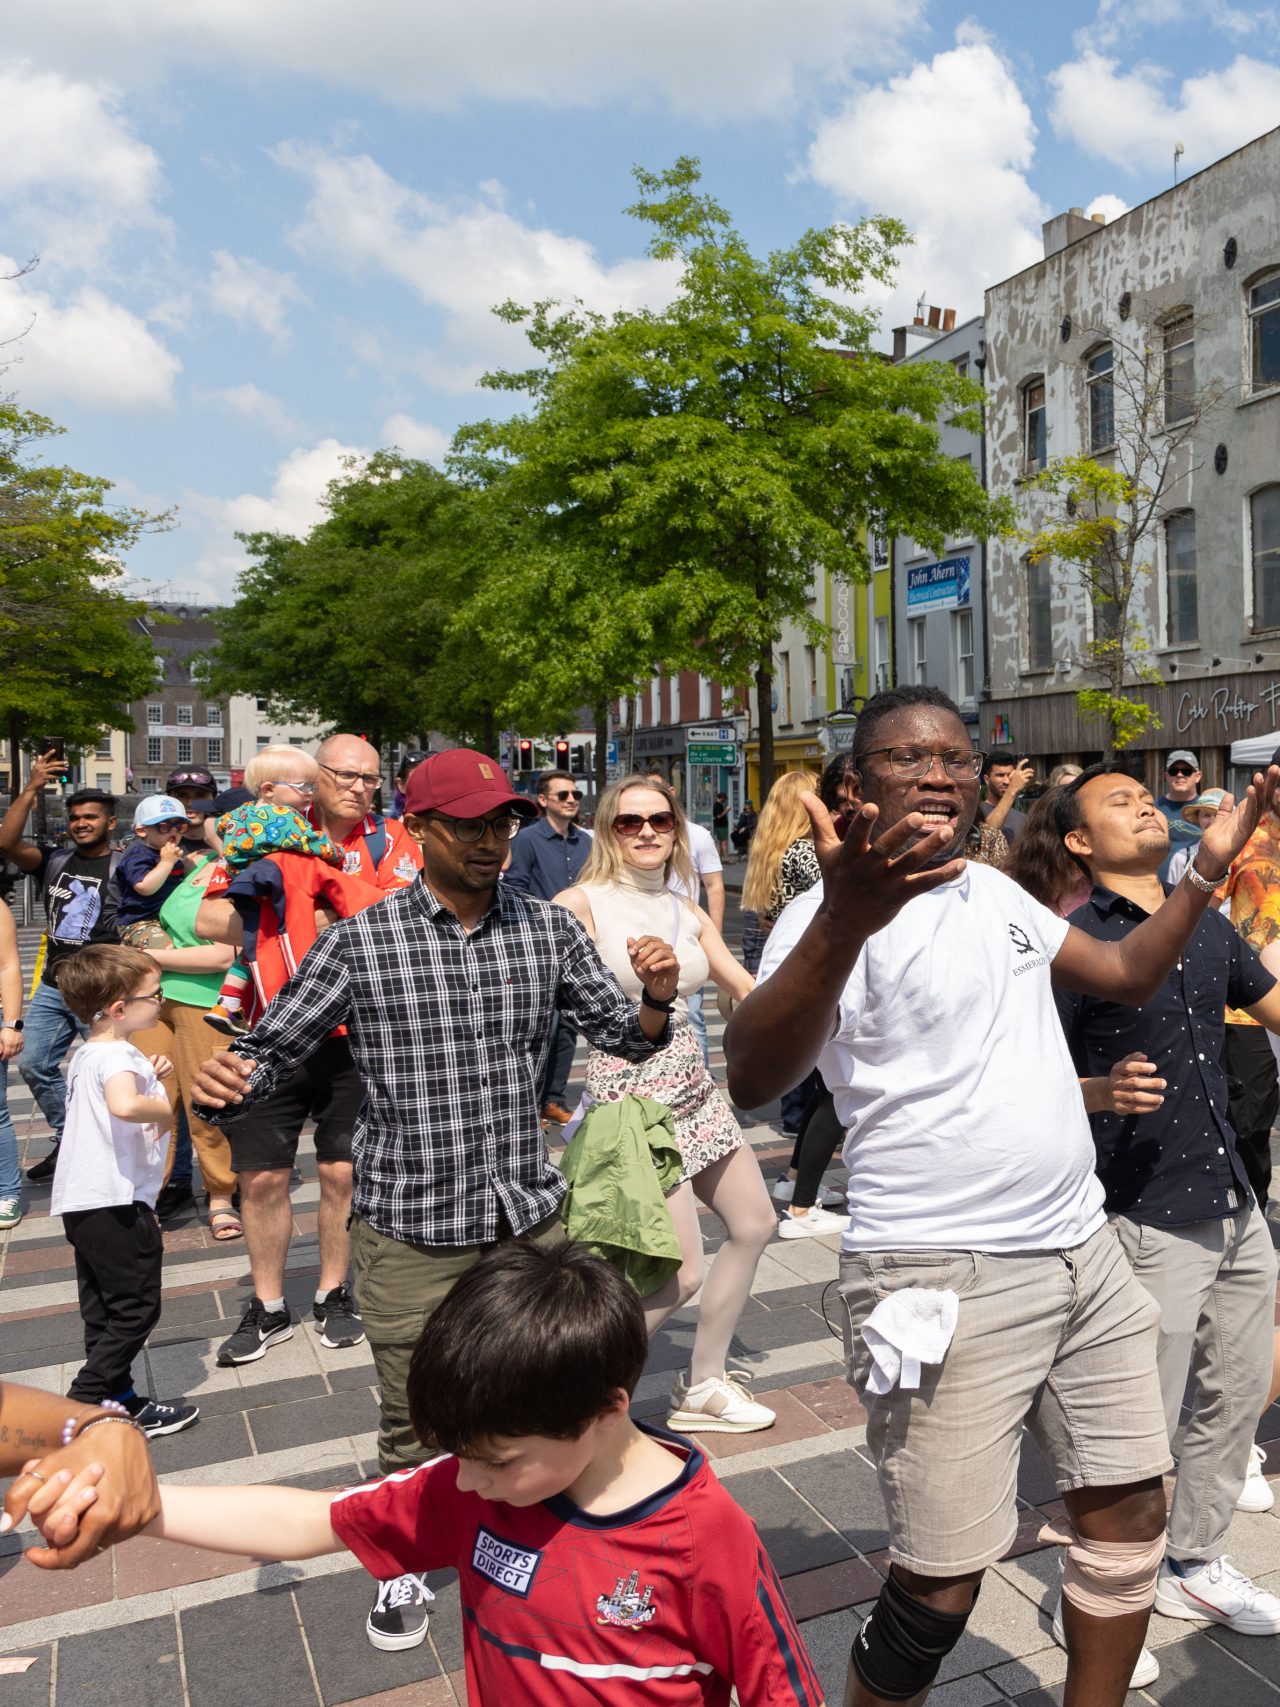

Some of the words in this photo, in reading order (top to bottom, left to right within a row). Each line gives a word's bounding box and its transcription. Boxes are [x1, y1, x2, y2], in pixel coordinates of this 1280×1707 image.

[908, 568, 928, 589] John
[929, 564, 955, 583] Ahern
[480, 1535, 532, 1569] SPORTS
[476, 1554, 524, 1587] DIRECT
